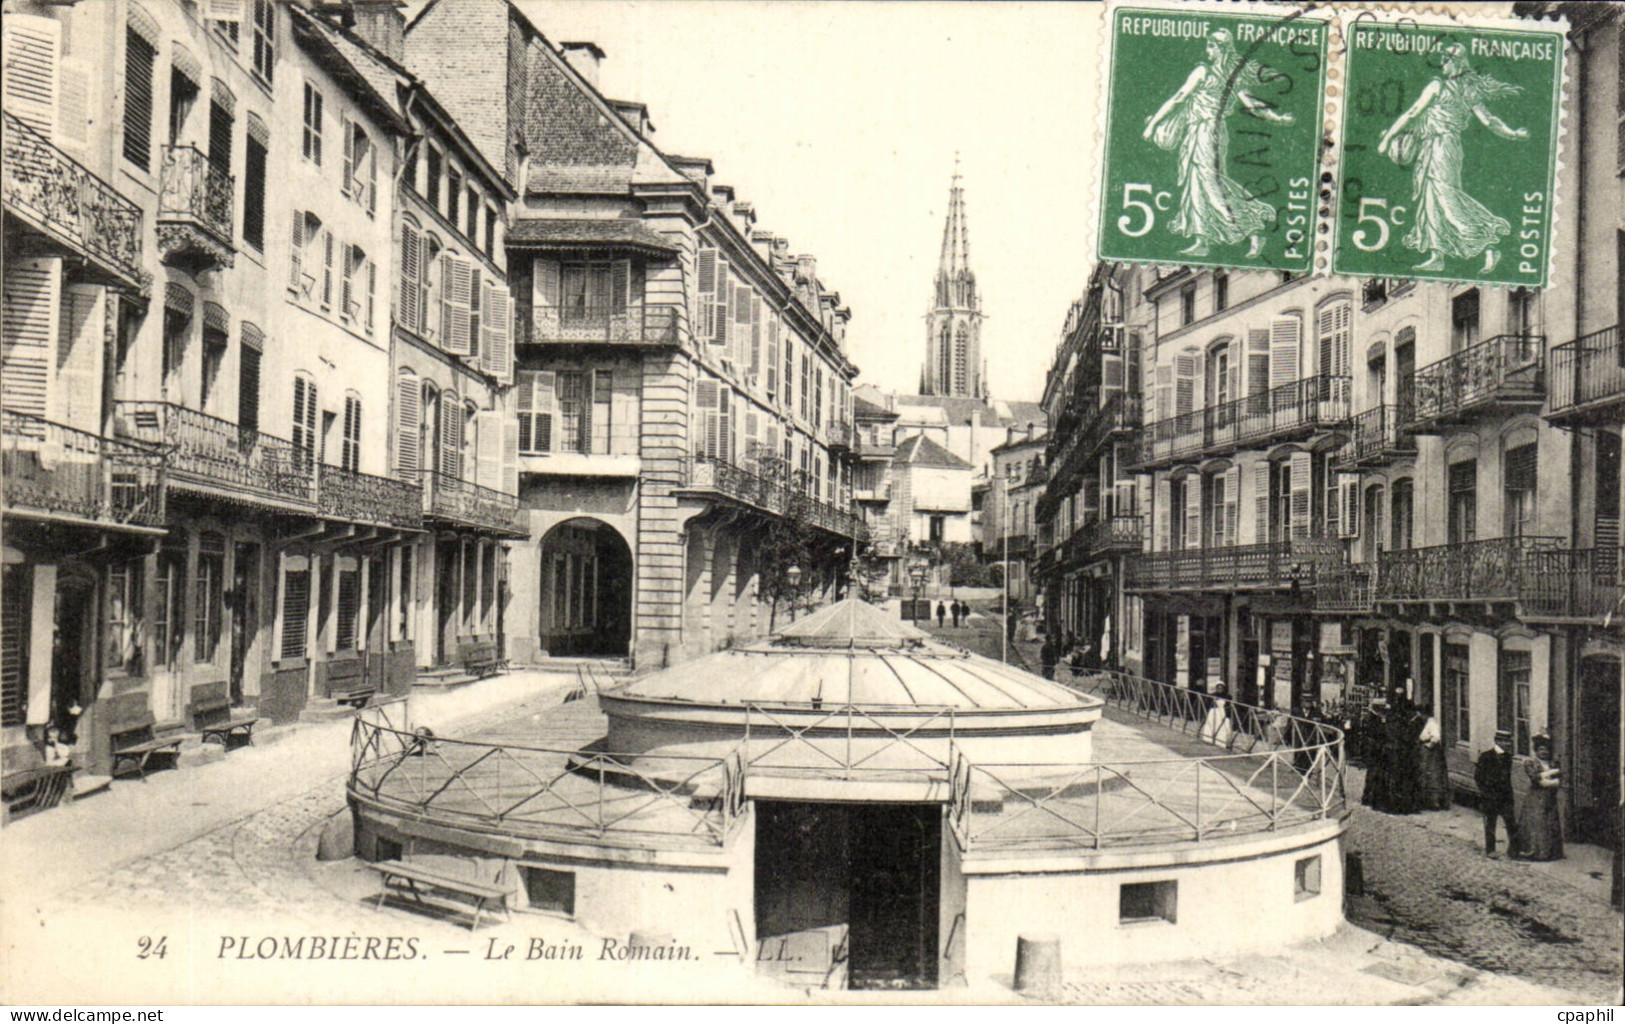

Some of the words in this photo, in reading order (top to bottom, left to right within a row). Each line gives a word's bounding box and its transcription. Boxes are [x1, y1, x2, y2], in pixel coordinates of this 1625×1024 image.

[1122, 16, 1210, 41] REPUBLIQUE
[1237, 23, 1319, 47] FRANÇAISE
[1471, 37, 1553, 61] FRANÇAISE
[1284, 176, 1310, 260] POSTES
[1518, 190, 1544, 274] POSTES
